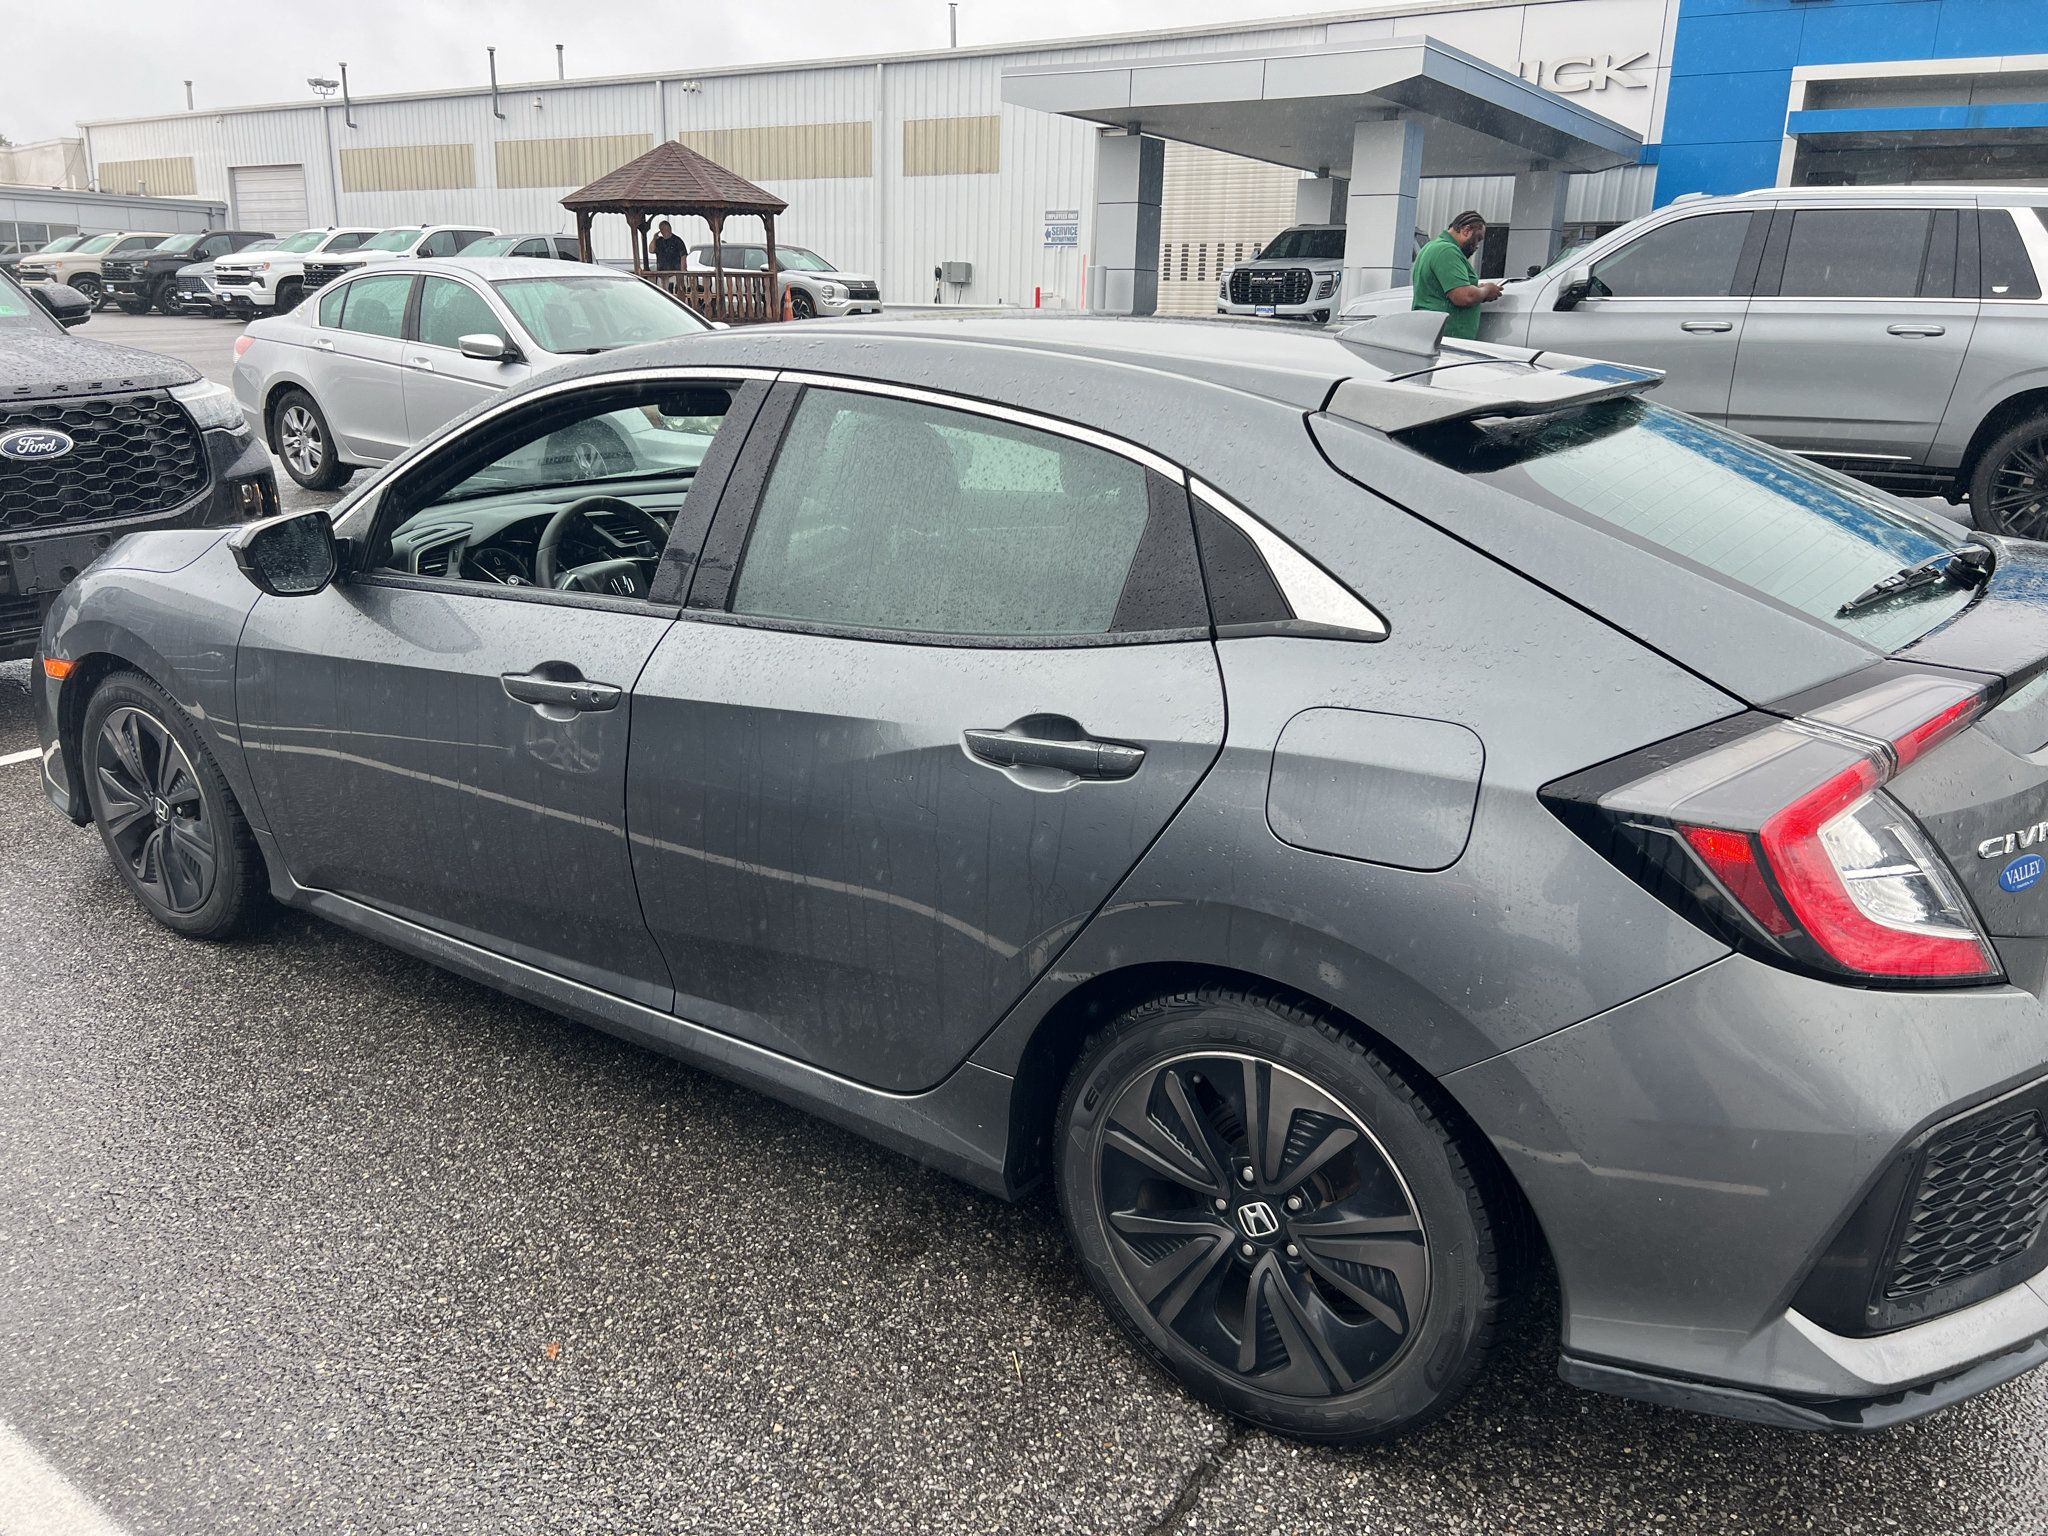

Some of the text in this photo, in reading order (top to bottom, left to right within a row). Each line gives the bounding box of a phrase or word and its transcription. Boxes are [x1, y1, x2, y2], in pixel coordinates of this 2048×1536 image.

[1051, 227, 1077, 236] SERVICE
[16, 436, 57, 454] Ford
[1978, 821, 2048, 859] CIVI
[2006, 859, 2041, 885] VALLEY
[1083, 1041, 1146, 1113] EDGE
